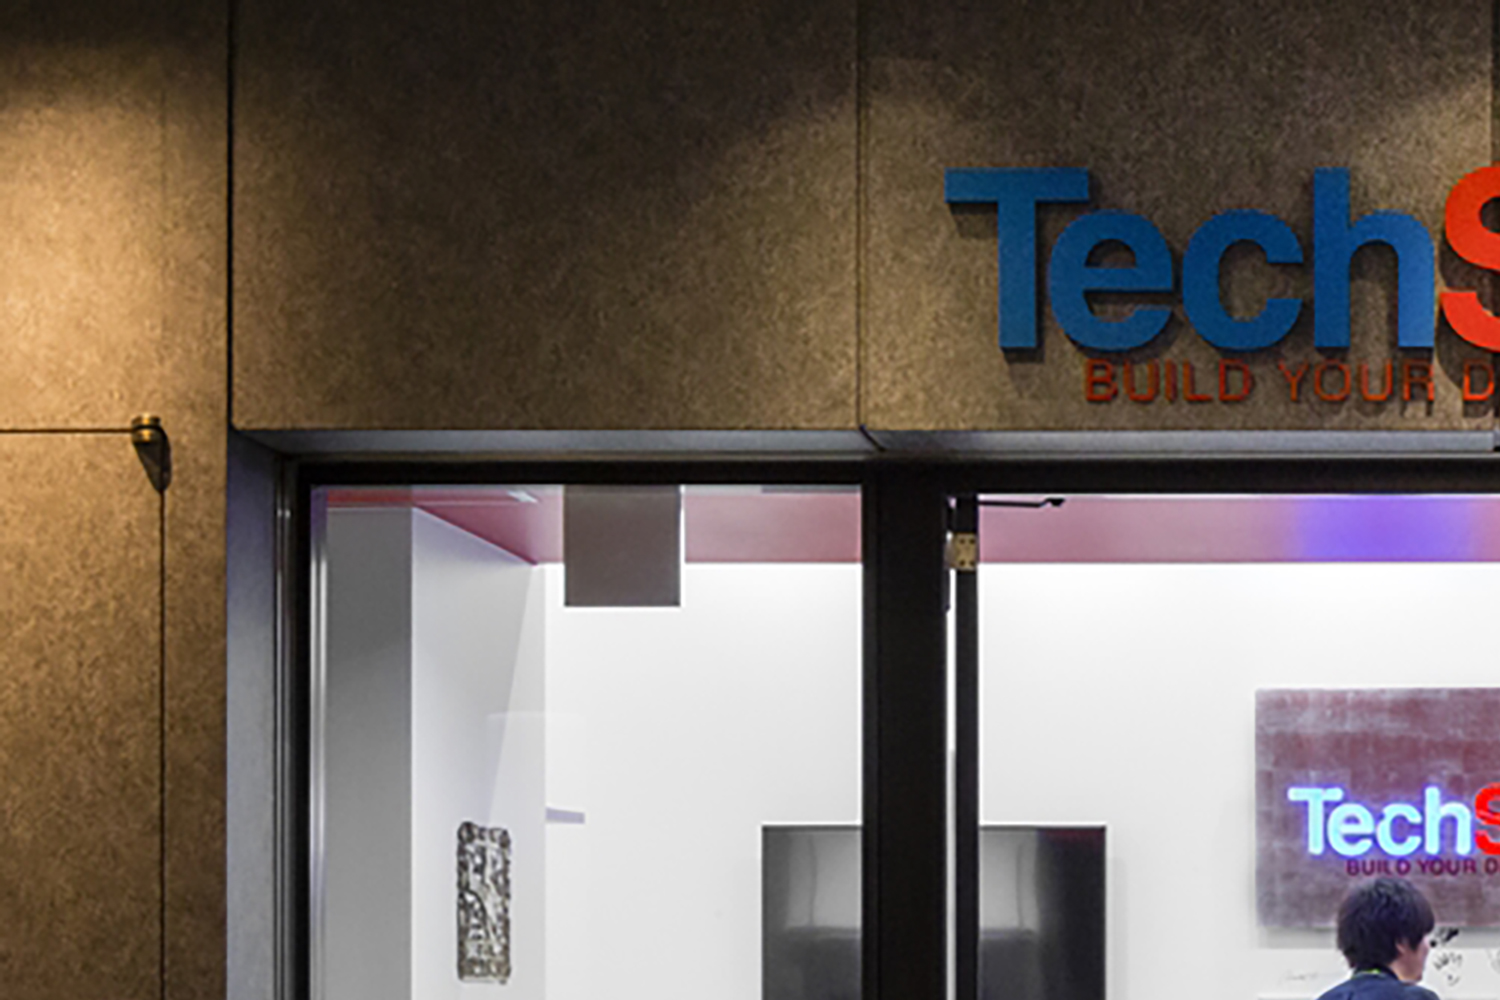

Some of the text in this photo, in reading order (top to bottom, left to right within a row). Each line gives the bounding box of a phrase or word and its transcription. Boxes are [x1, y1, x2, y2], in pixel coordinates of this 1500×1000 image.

[1085, 358, 1254, 402] BUILD
[1280, 358, 1434, 402] YOUR
[1346, 857, 1411, 875] BUILD
[1419, 857, 1477, 875] YOUR
